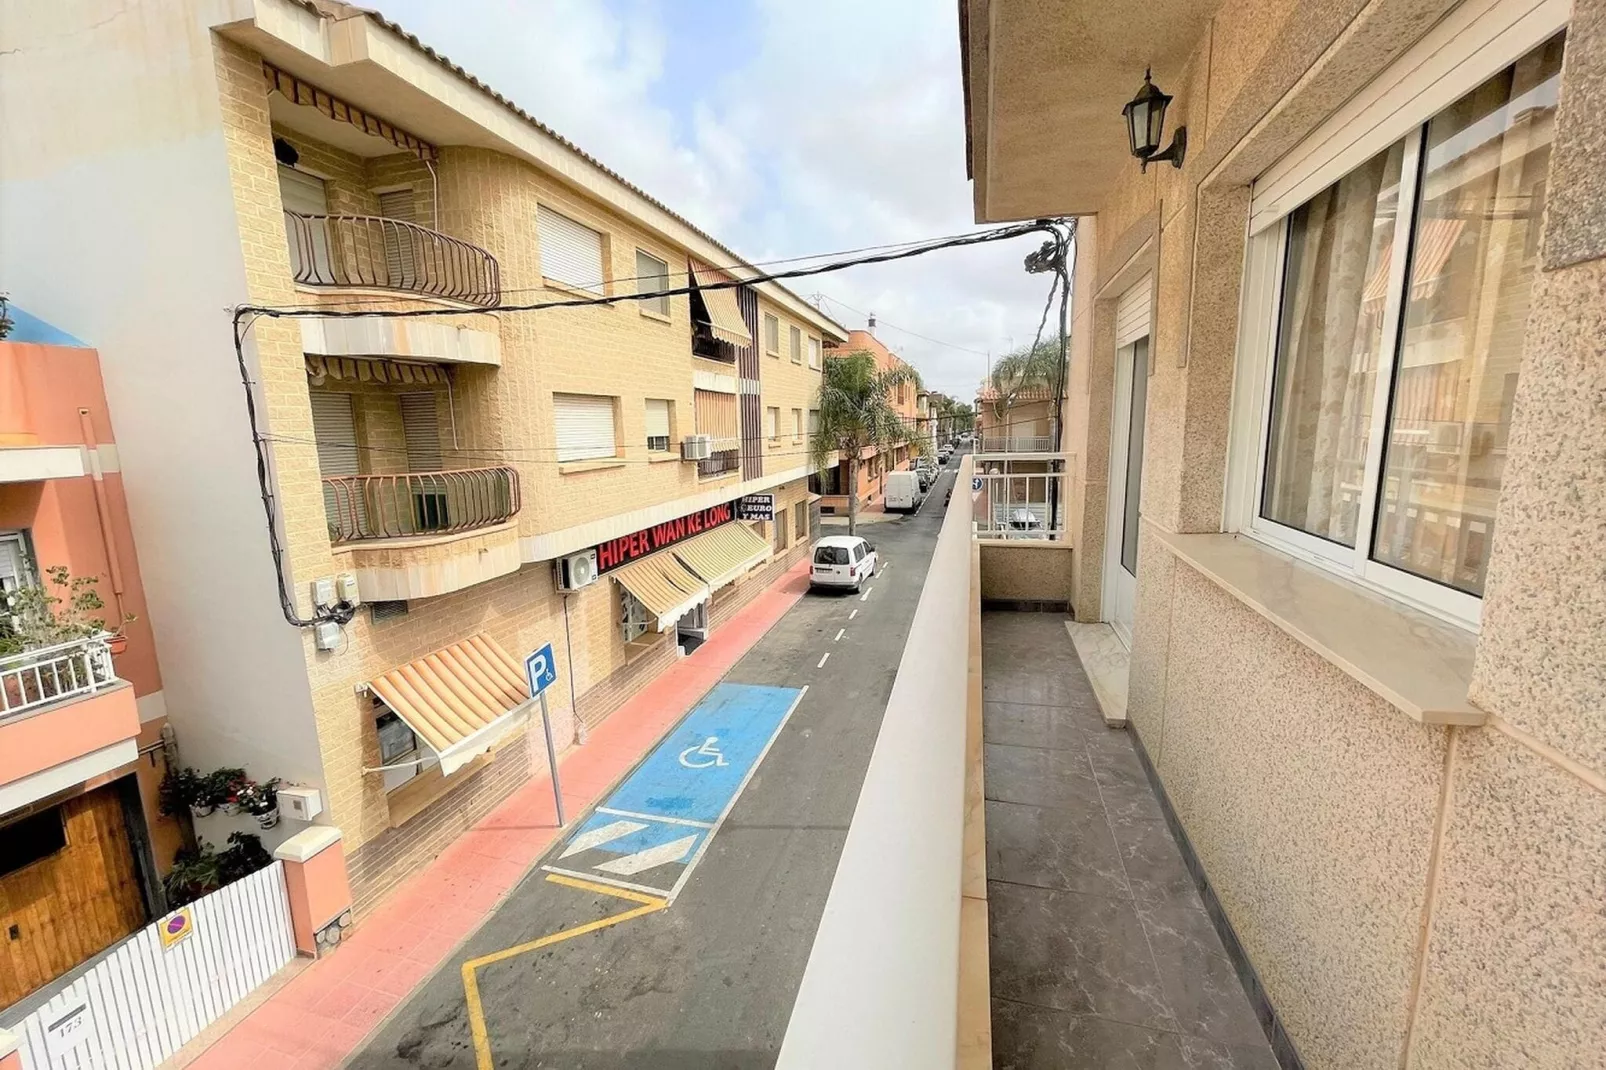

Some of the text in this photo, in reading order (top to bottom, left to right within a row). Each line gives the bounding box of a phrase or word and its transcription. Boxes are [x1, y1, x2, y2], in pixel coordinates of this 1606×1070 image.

[599, 503, 730, 569] HIPER WAN KE LONG
[529, 654, 547, 693] P
[60, 1016, 82, 1038] 173
